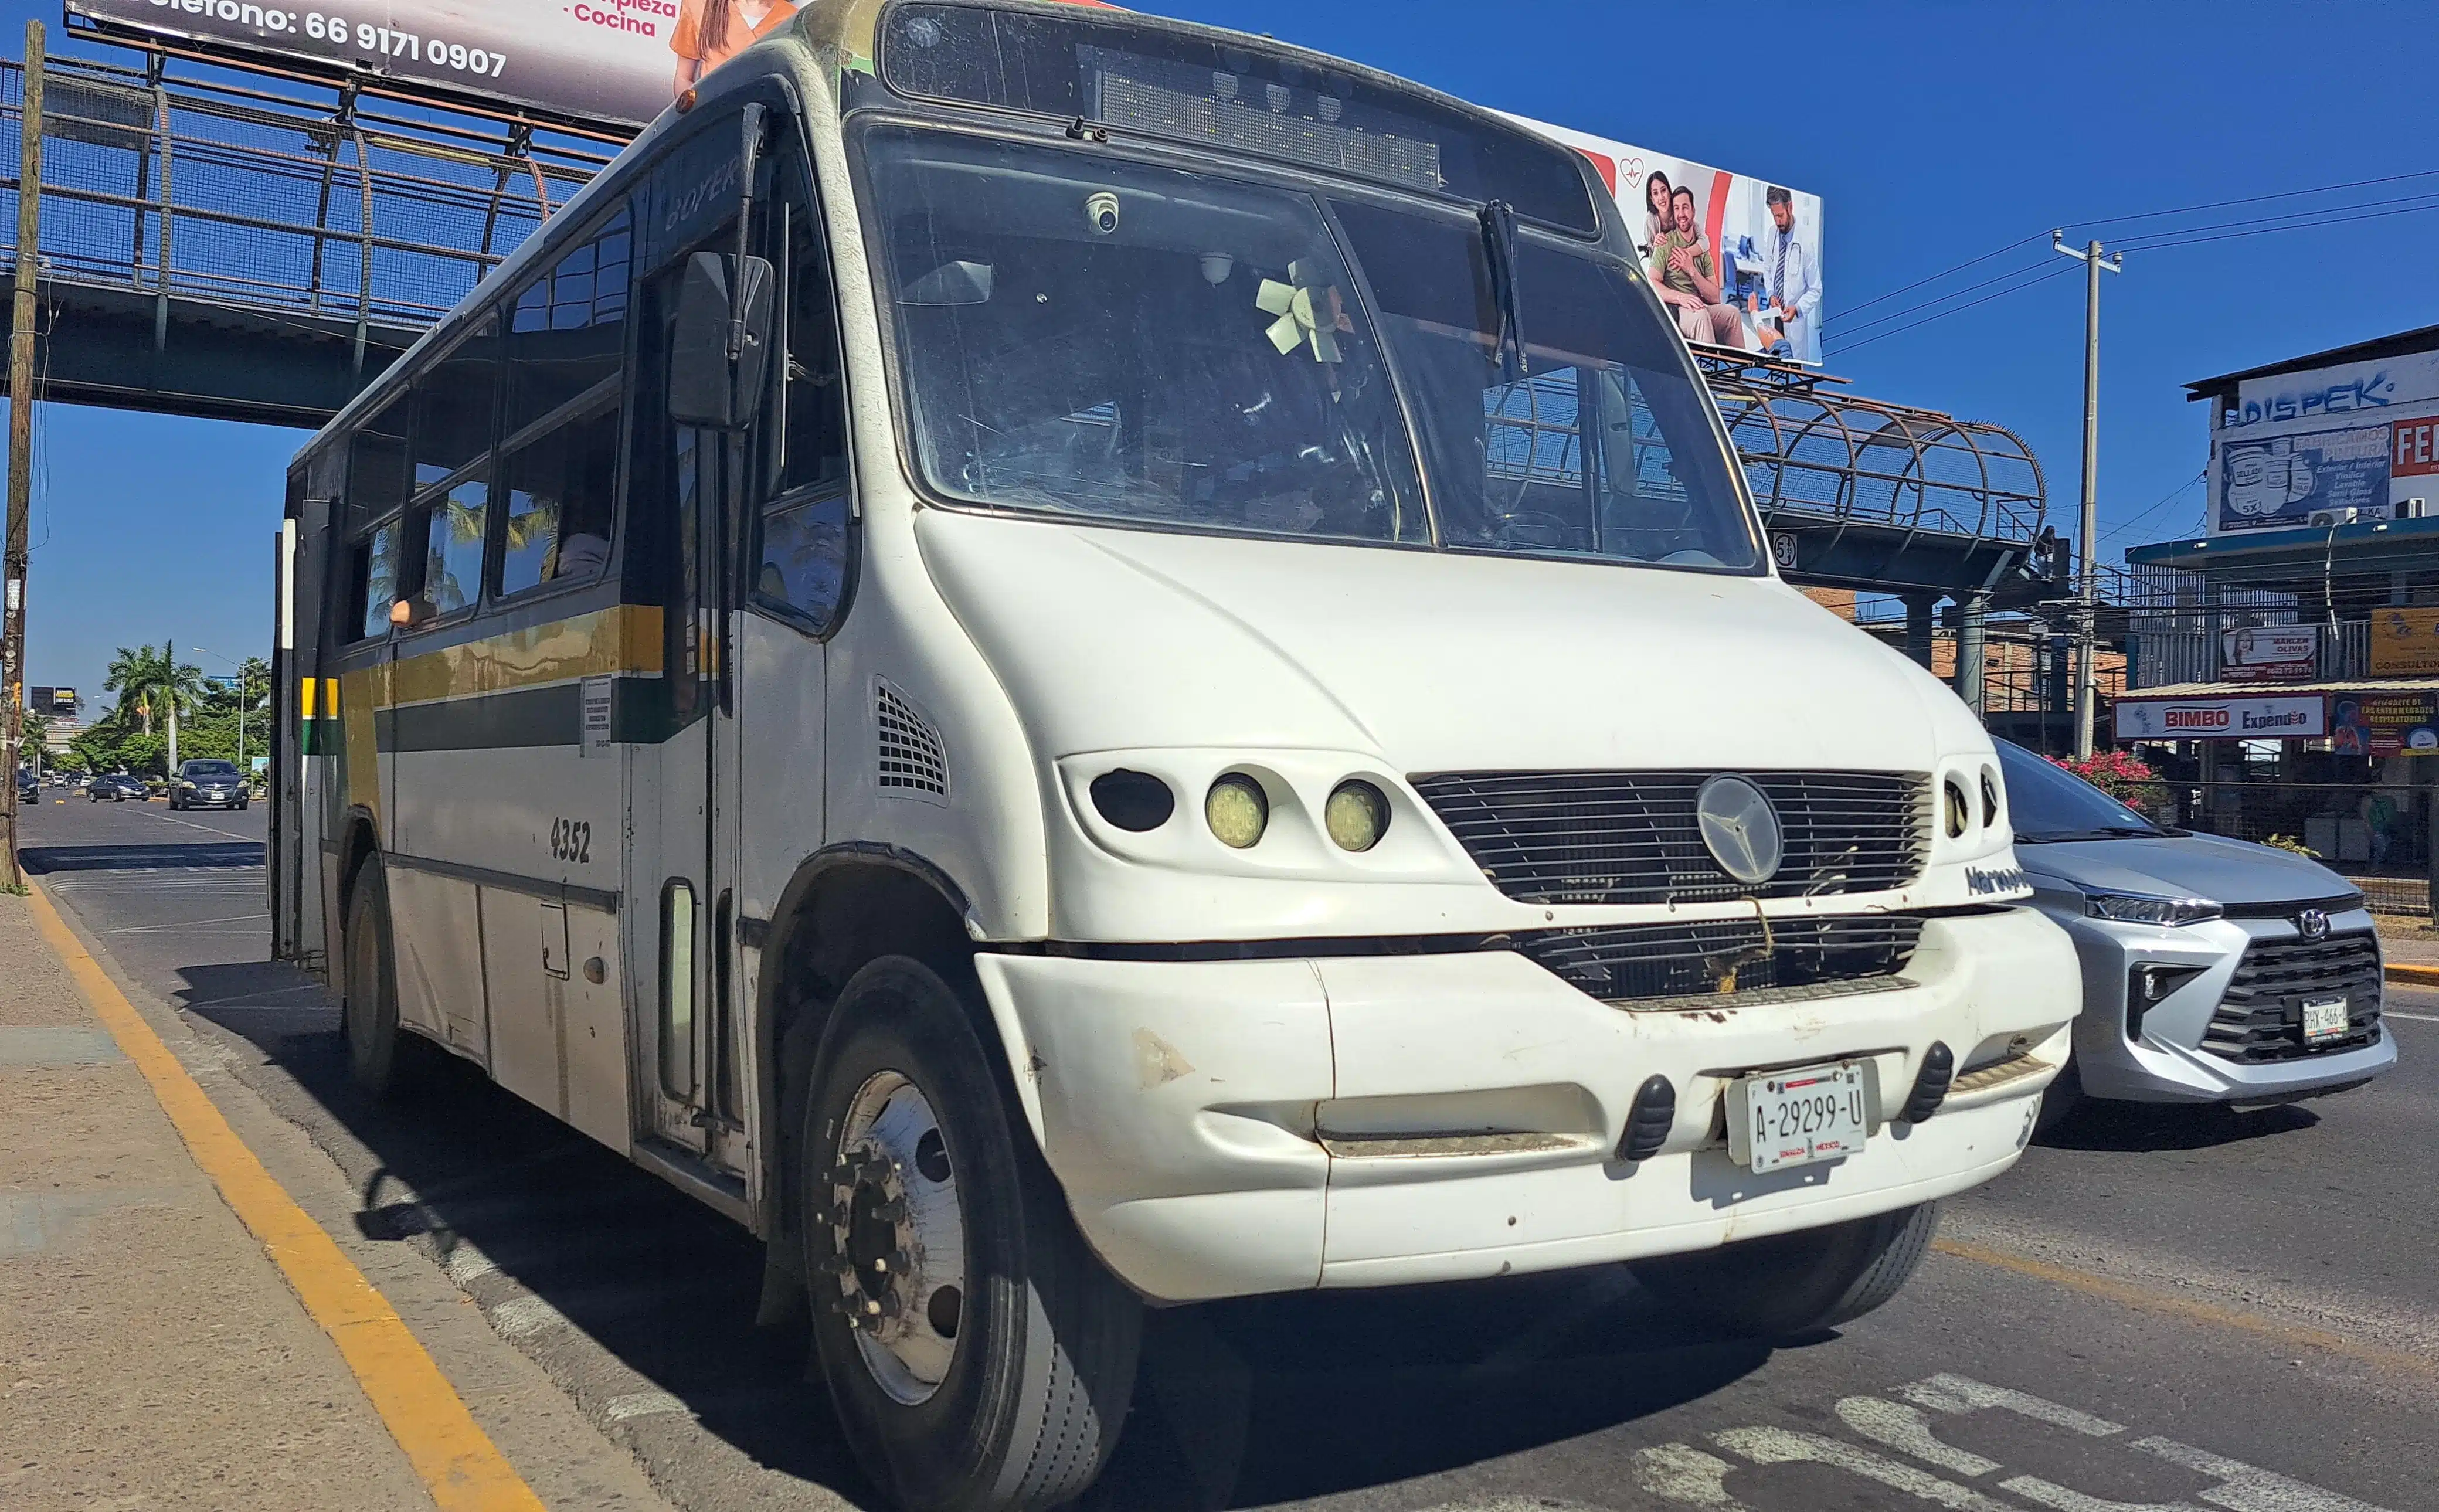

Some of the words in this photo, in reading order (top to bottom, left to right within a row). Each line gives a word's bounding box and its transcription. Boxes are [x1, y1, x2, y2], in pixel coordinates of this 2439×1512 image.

[574, 4, 655, 37] Cocina
[305, 12, 348, 43] 66
[356, 23, 419, 61] 9171
[427, 39, 507, 78] 0907
[2165, 710, 2230, 727] BIMBO
[551, 816, 590, 864] 4352
[1756, 1089, 1863, 1144] A-29299-U
